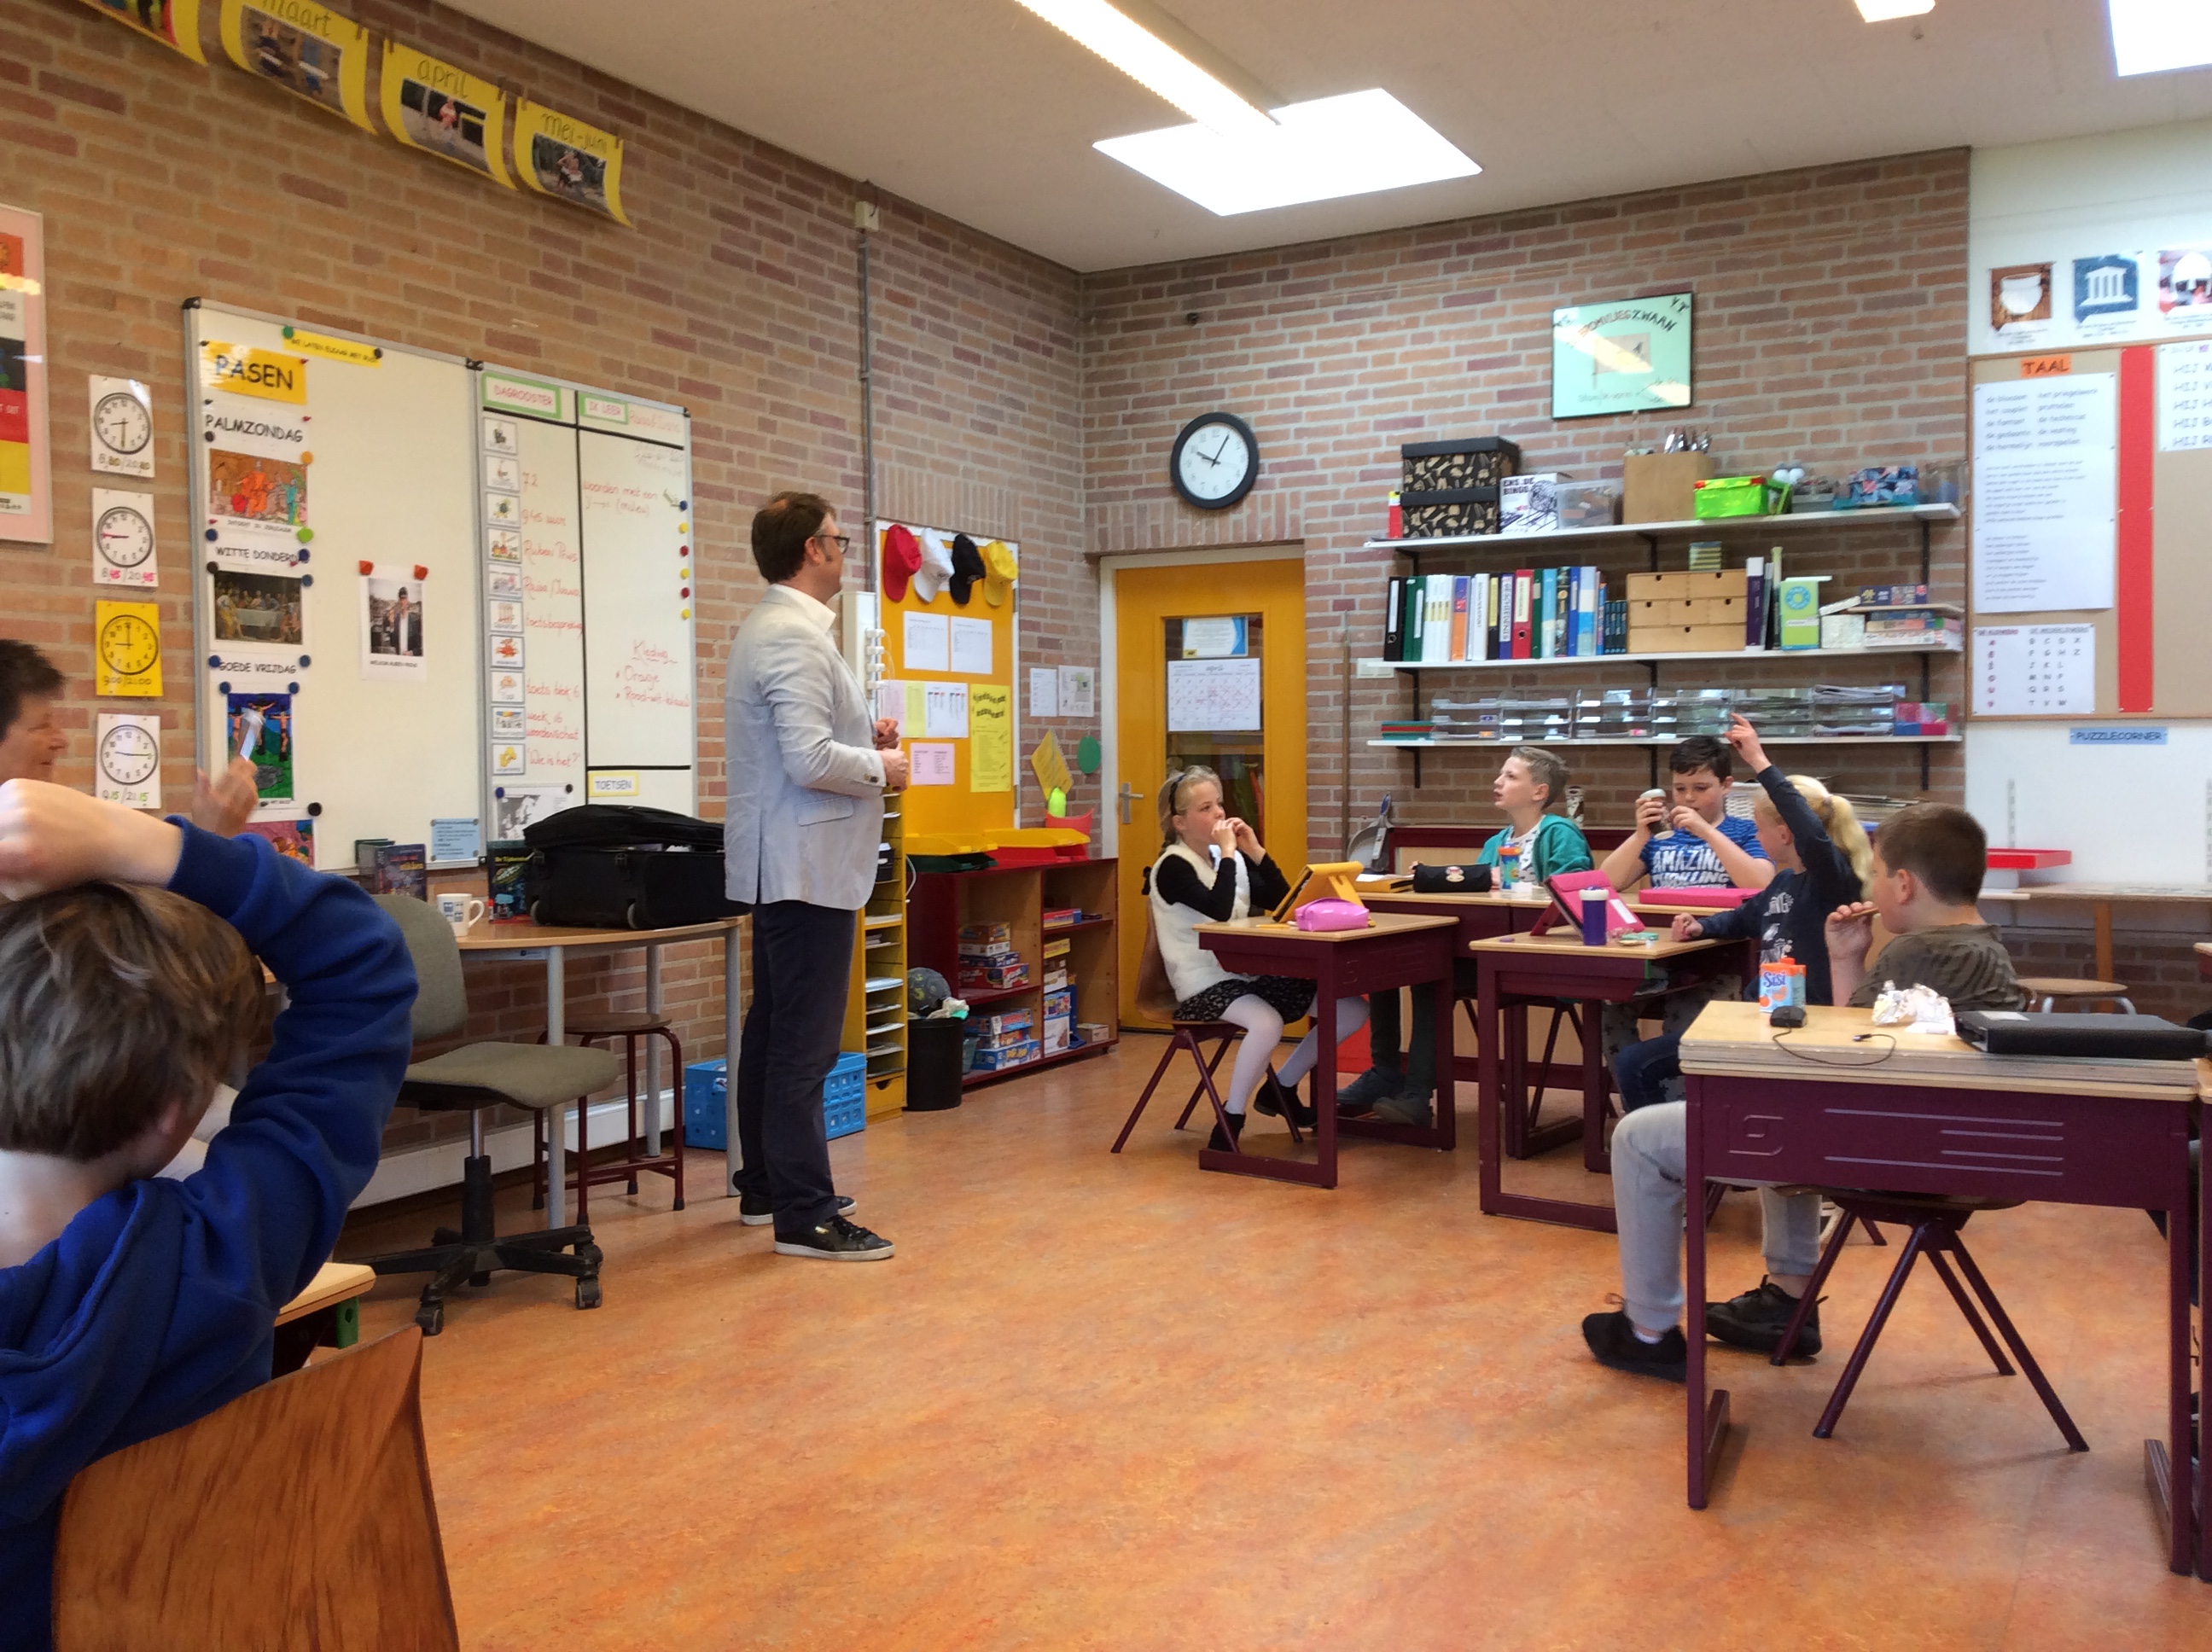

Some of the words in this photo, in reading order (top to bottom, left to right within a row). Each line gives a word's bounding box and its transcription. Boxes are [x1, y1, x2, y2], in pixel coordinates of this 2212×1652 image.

[416, 59, 468, 99] april
[215, 354, 294, 391] PASEN
[2022, 359, 2070, 375] TAAL
[206, 414, 304, 443] PALMZONDAG
[216, 546, 250, 559] WITTE
[253, 550, 309, 563] DONDERD
[255, 663, 296, 674] VRIJDAG
[2075, 730, 2163, 741] PUZZLECORNER
[594, 779, 633, 790] TOETSEN
